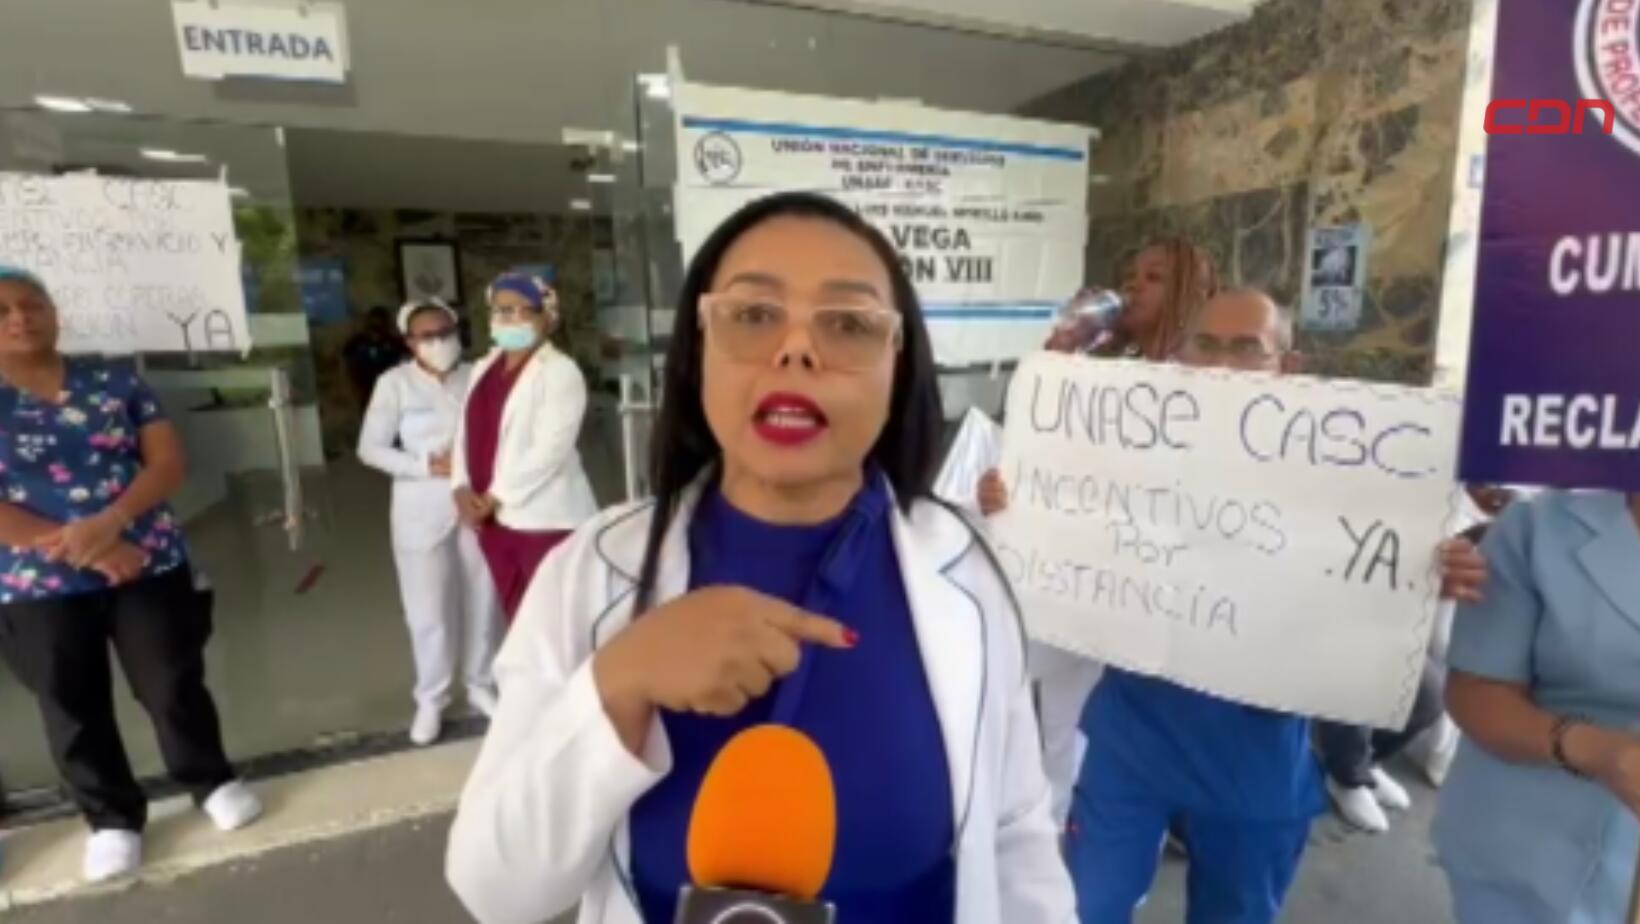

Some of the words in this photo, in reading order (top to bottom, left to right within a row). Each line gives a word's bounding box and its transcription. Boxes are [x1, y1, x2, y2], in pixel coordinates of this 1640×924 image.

[183, 25, 333, 61] ENTRADA
[892, 224, 971, 250] VEGA
[944, 256, 993, 283] VIII
[165, 309, 236, 350] YA
[1239, 394, 1437, 478] CASC
